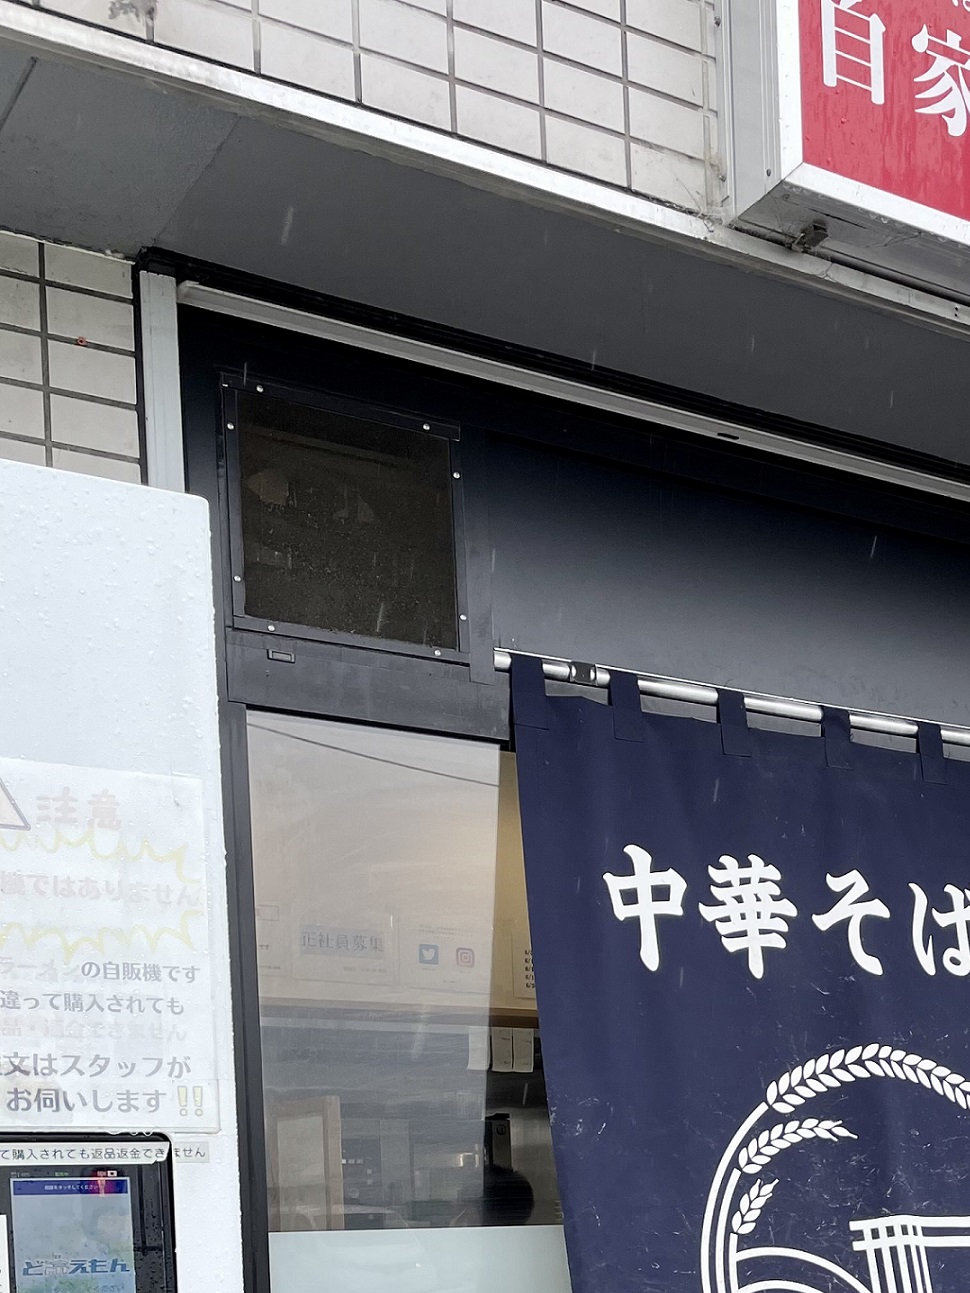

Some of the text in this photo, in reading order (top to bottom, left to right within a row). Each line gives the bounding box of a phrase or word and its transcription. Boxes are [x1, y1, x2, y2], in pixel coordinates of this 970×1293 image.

[0, 1052, 190, 1079] 文はスタッフが
